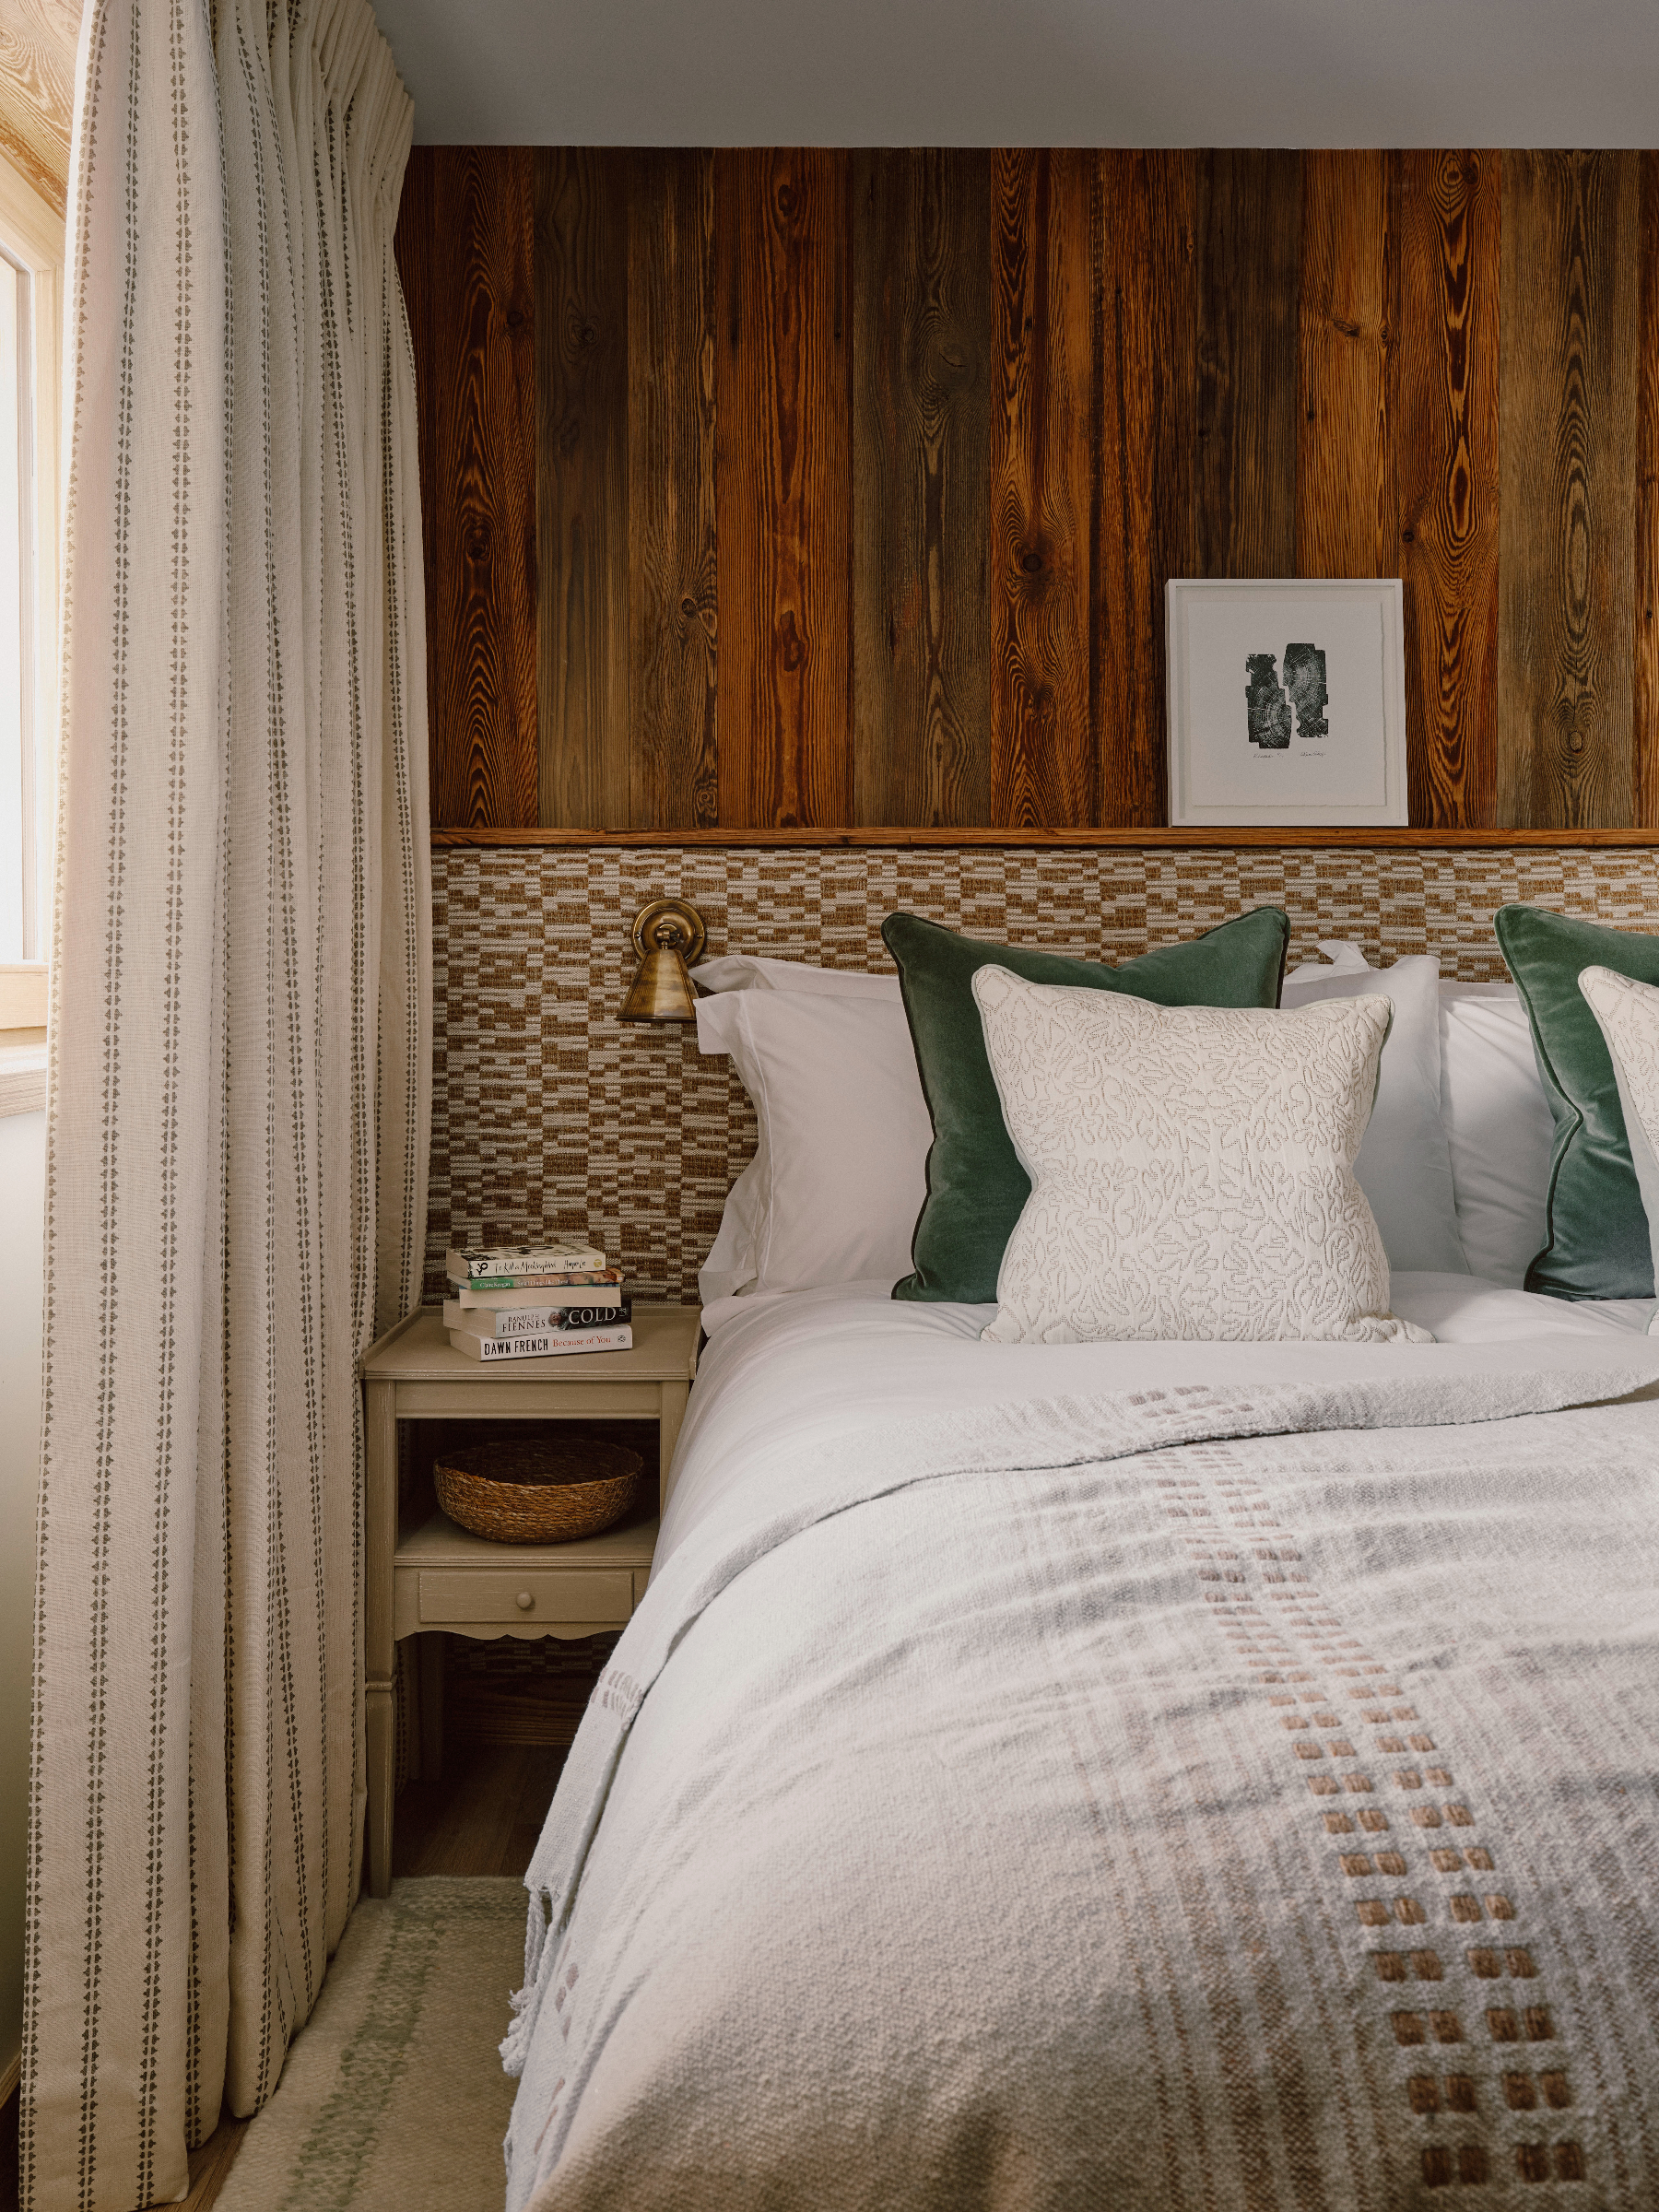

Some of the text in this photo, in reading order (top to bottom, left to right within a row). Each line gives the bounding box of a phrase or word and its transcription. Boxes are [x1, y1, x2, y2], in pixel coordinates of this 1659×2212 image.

[503, 1262, 514, 1274] Kill
[520, 1260, 557, 1272] Mockingbird
[508, 1313, 540, 1323] RANULPH
[569, 1307, 617, 1324] COLD
[502, 1320, 546, 1333] FIENNES
[484, 1338, 549, 1356] DAWN FRENCH
[552, 1335, 611, 1347] Because of You
